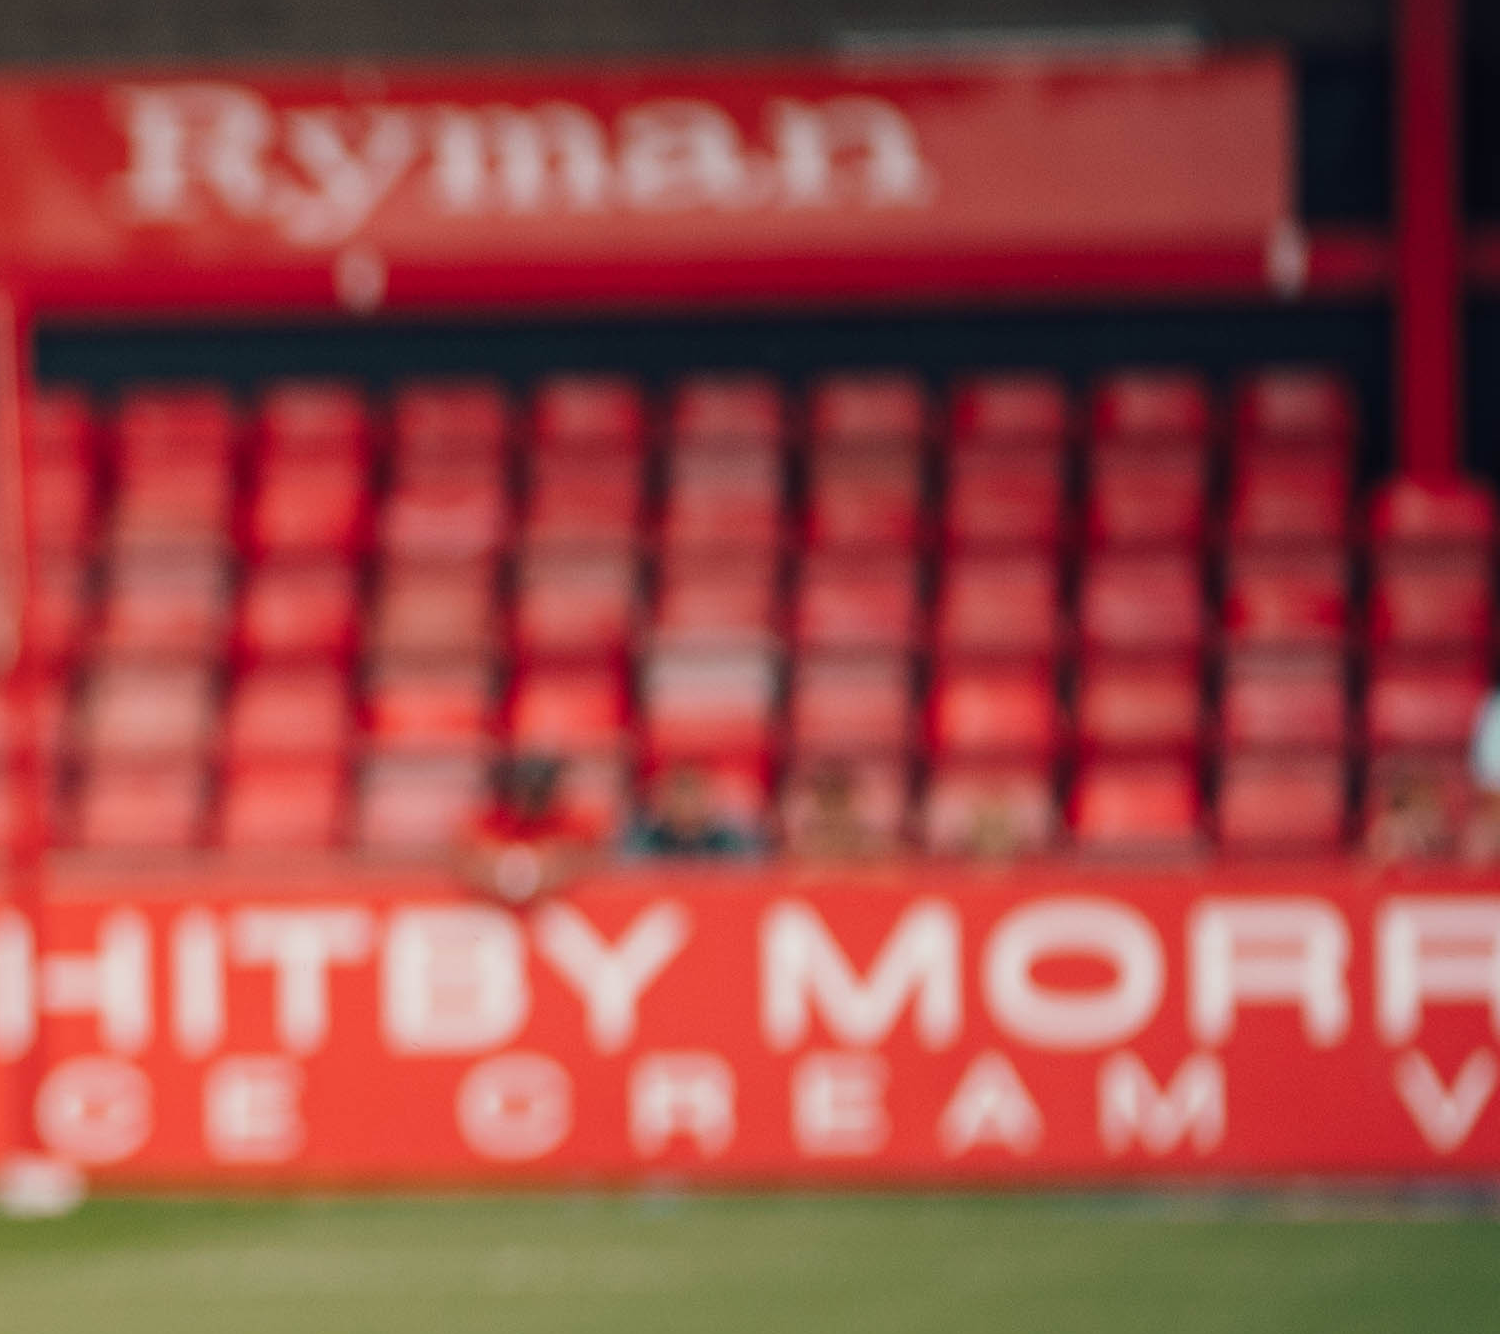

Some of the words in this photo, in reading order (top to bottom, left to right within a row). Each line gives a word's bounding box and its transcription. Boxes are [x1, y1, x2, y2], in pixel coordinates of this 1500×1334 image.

[106, 85, 936, 243] Ryman
[454, 1049, 1228, 1163] CREAM
[1395, 1046, 1500, 1155] V
